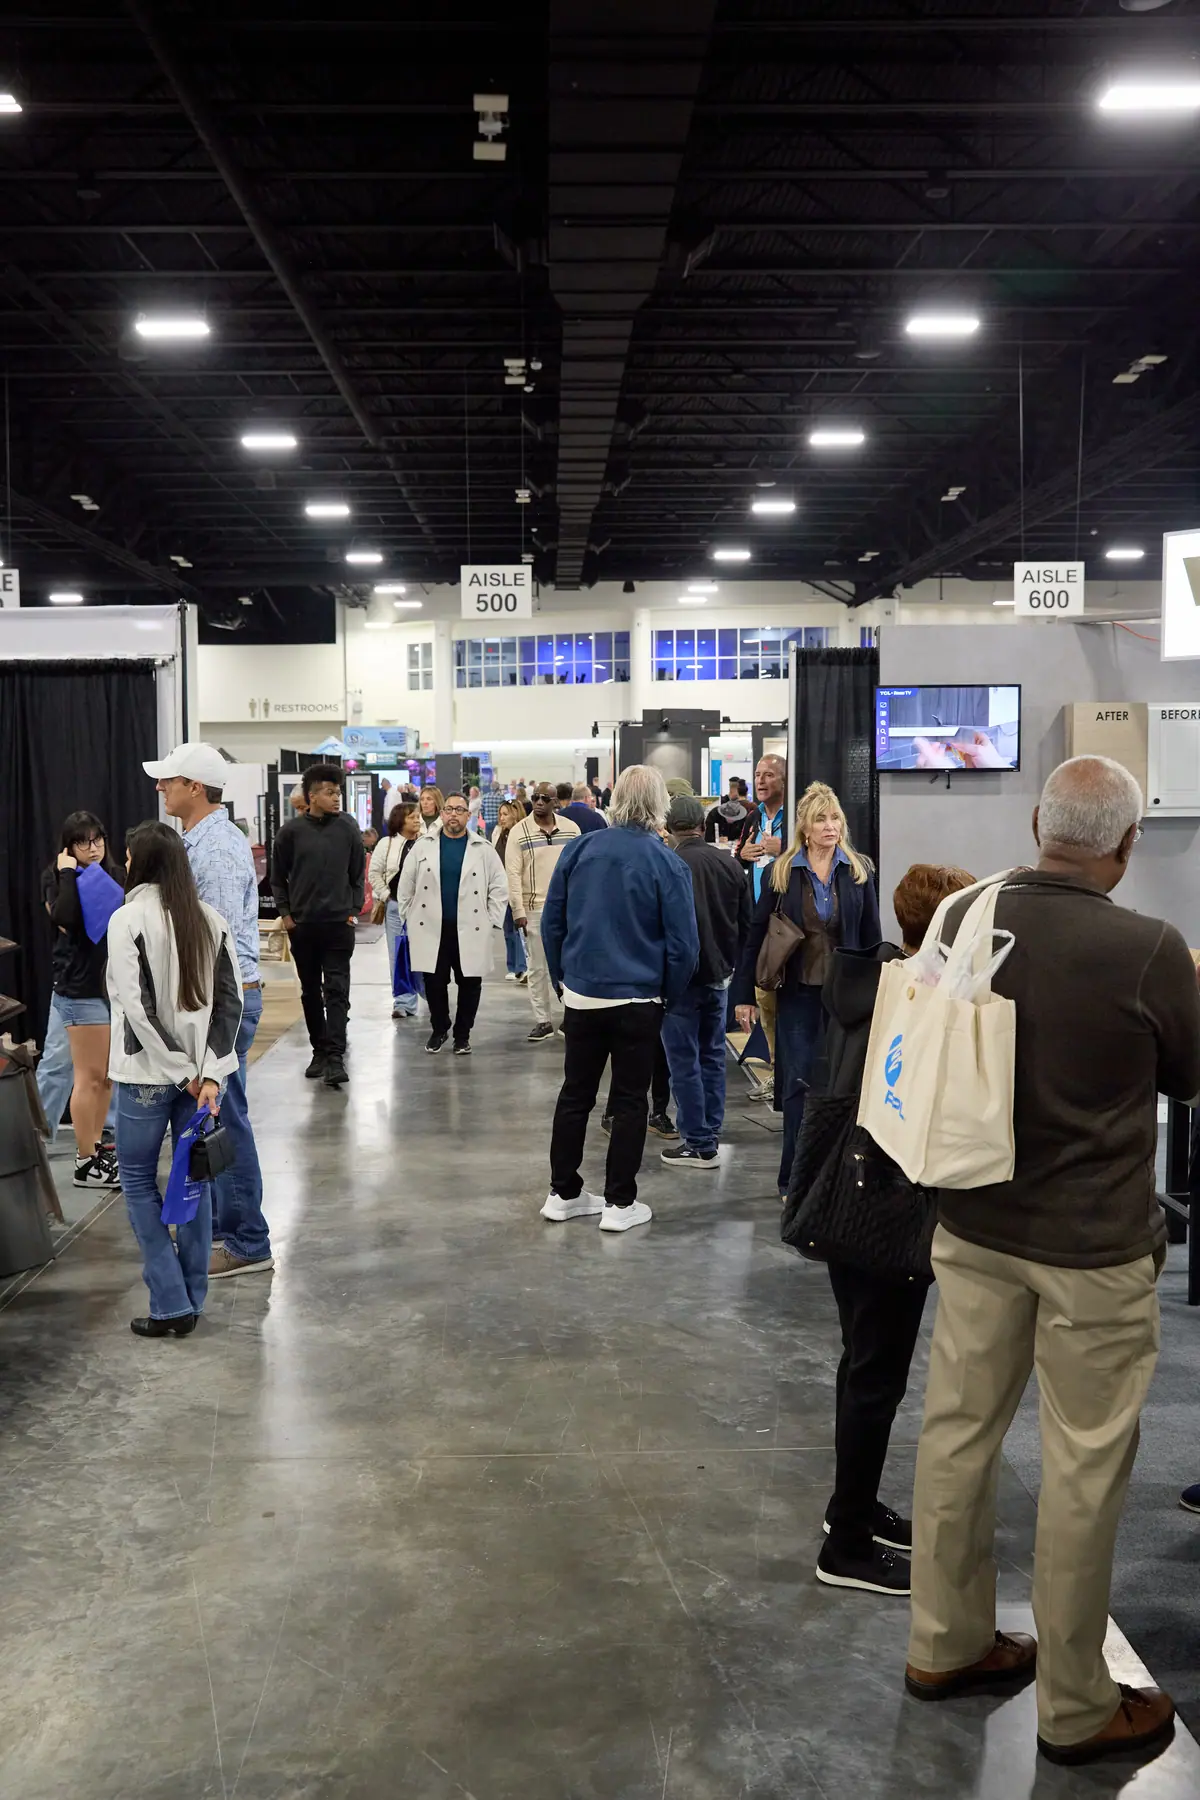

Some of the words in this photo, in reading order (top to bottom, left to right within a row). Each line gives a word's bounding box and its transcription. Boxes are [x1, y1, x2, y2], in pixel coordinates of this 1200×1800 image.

[468, 572, 526, 587] AISLE
[1022, 569, 1078, 583] AISLE
[476, 593, 518, 612] 500
[1029, 589, 1069, 609] 600
[274, 703, 339, 713] RESTROOMS
[1160, 709, 1200, 720] BEFOR
[1095, 711, 1129, 721] AFTER
